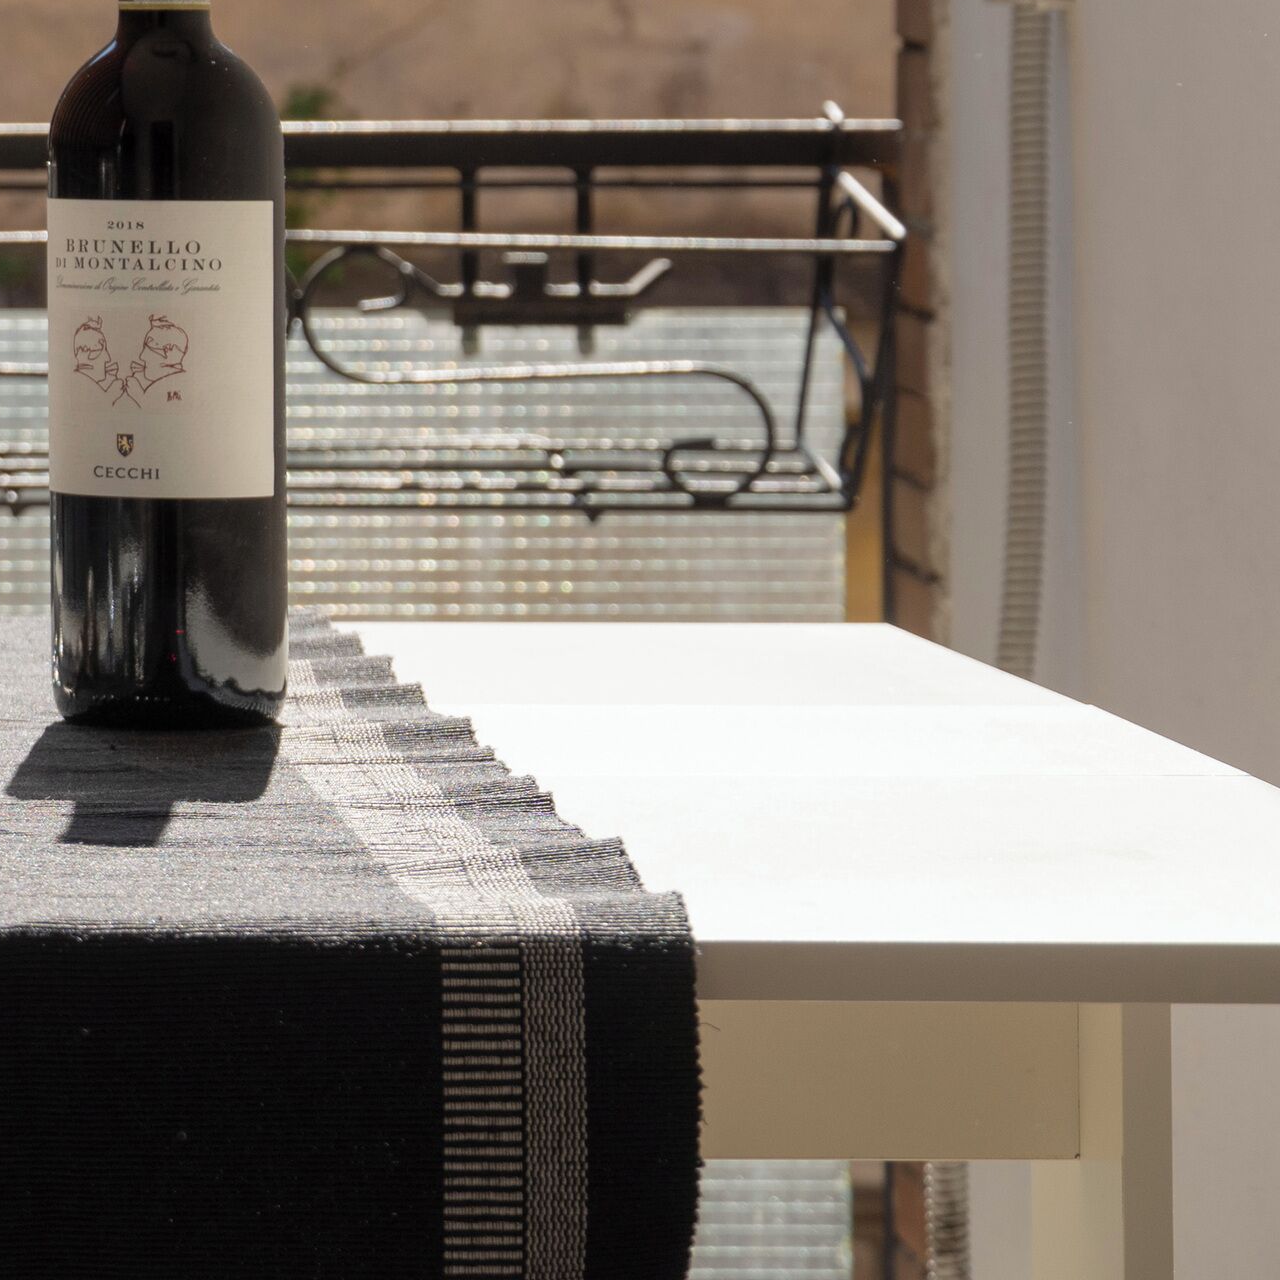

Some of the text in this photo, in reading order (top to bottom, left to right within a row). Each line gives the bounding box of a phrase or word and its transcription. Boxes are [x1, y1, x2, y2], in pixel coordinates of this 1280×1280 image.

[107, 221, 144, 230] 2018
[66, 238, 201, 255] BRUNELLO
[56, 257, 222, 271] DI MONTALCINO
[93, 466, 160, 479] CECCHI
